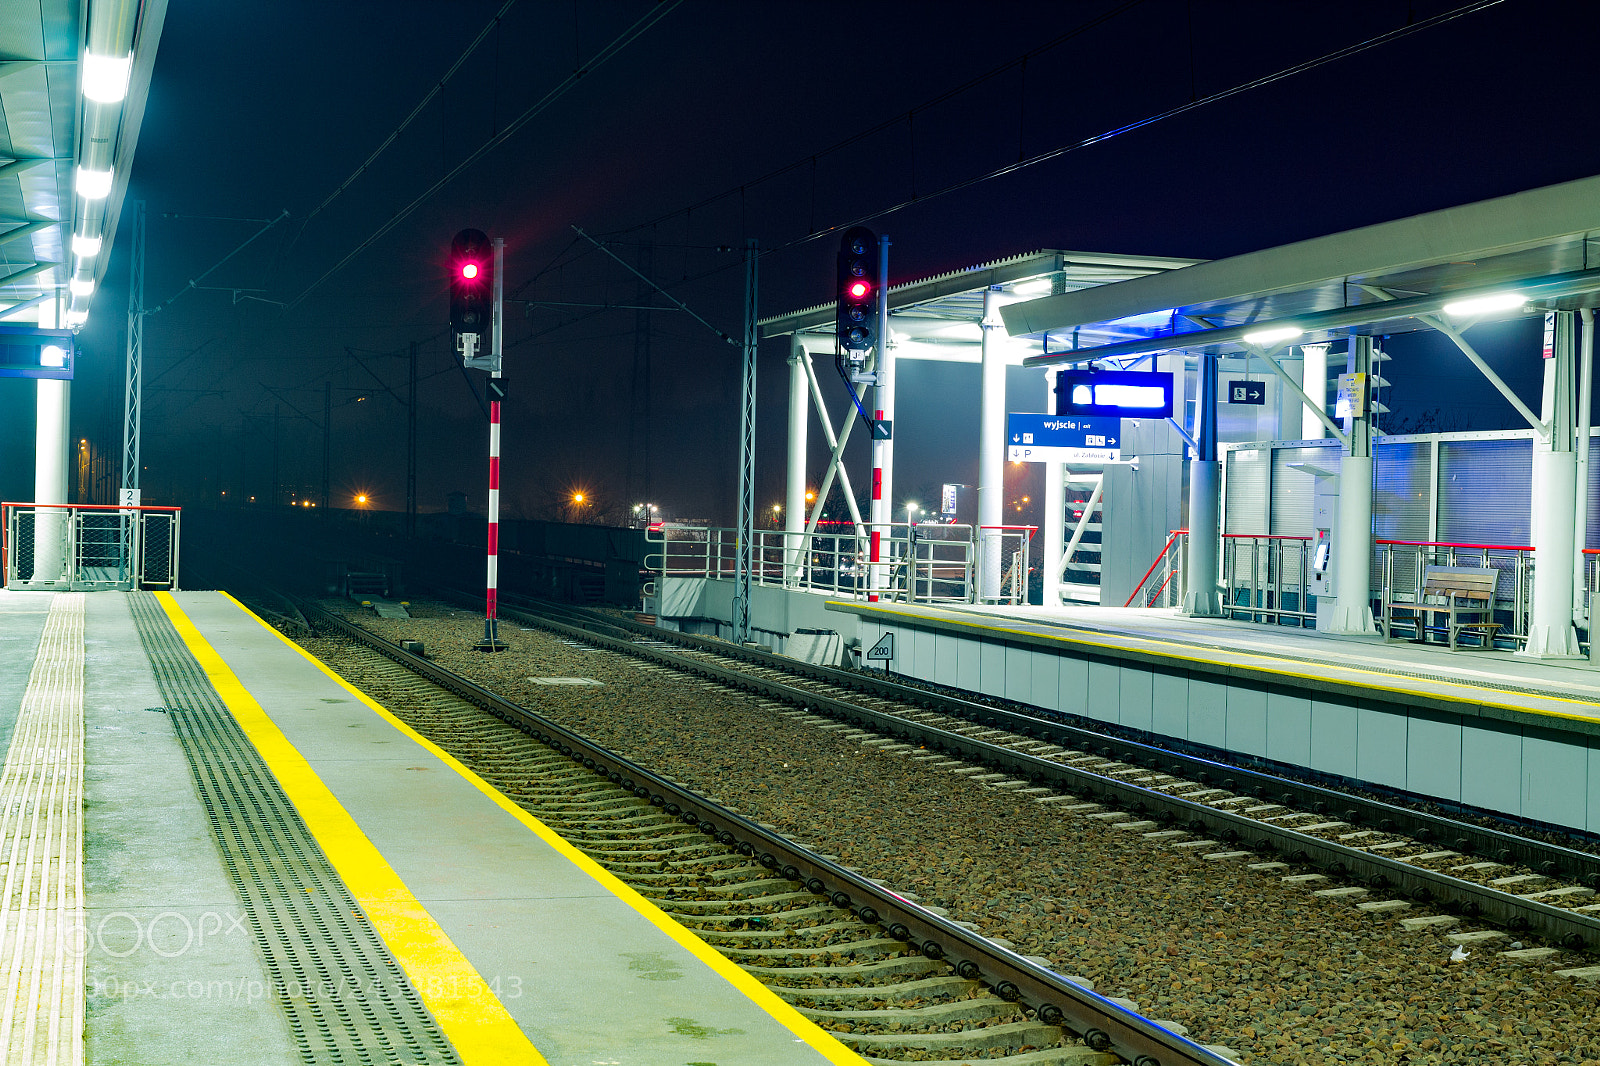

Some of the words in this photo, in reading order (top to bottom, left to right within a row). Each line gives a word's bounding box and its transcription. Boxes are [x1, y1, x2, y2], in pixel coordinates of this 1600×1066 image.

[1024, 449, 1032, 459] P
[126, 490, 133, 500] 2
[874, 646, 889, 656] 200
